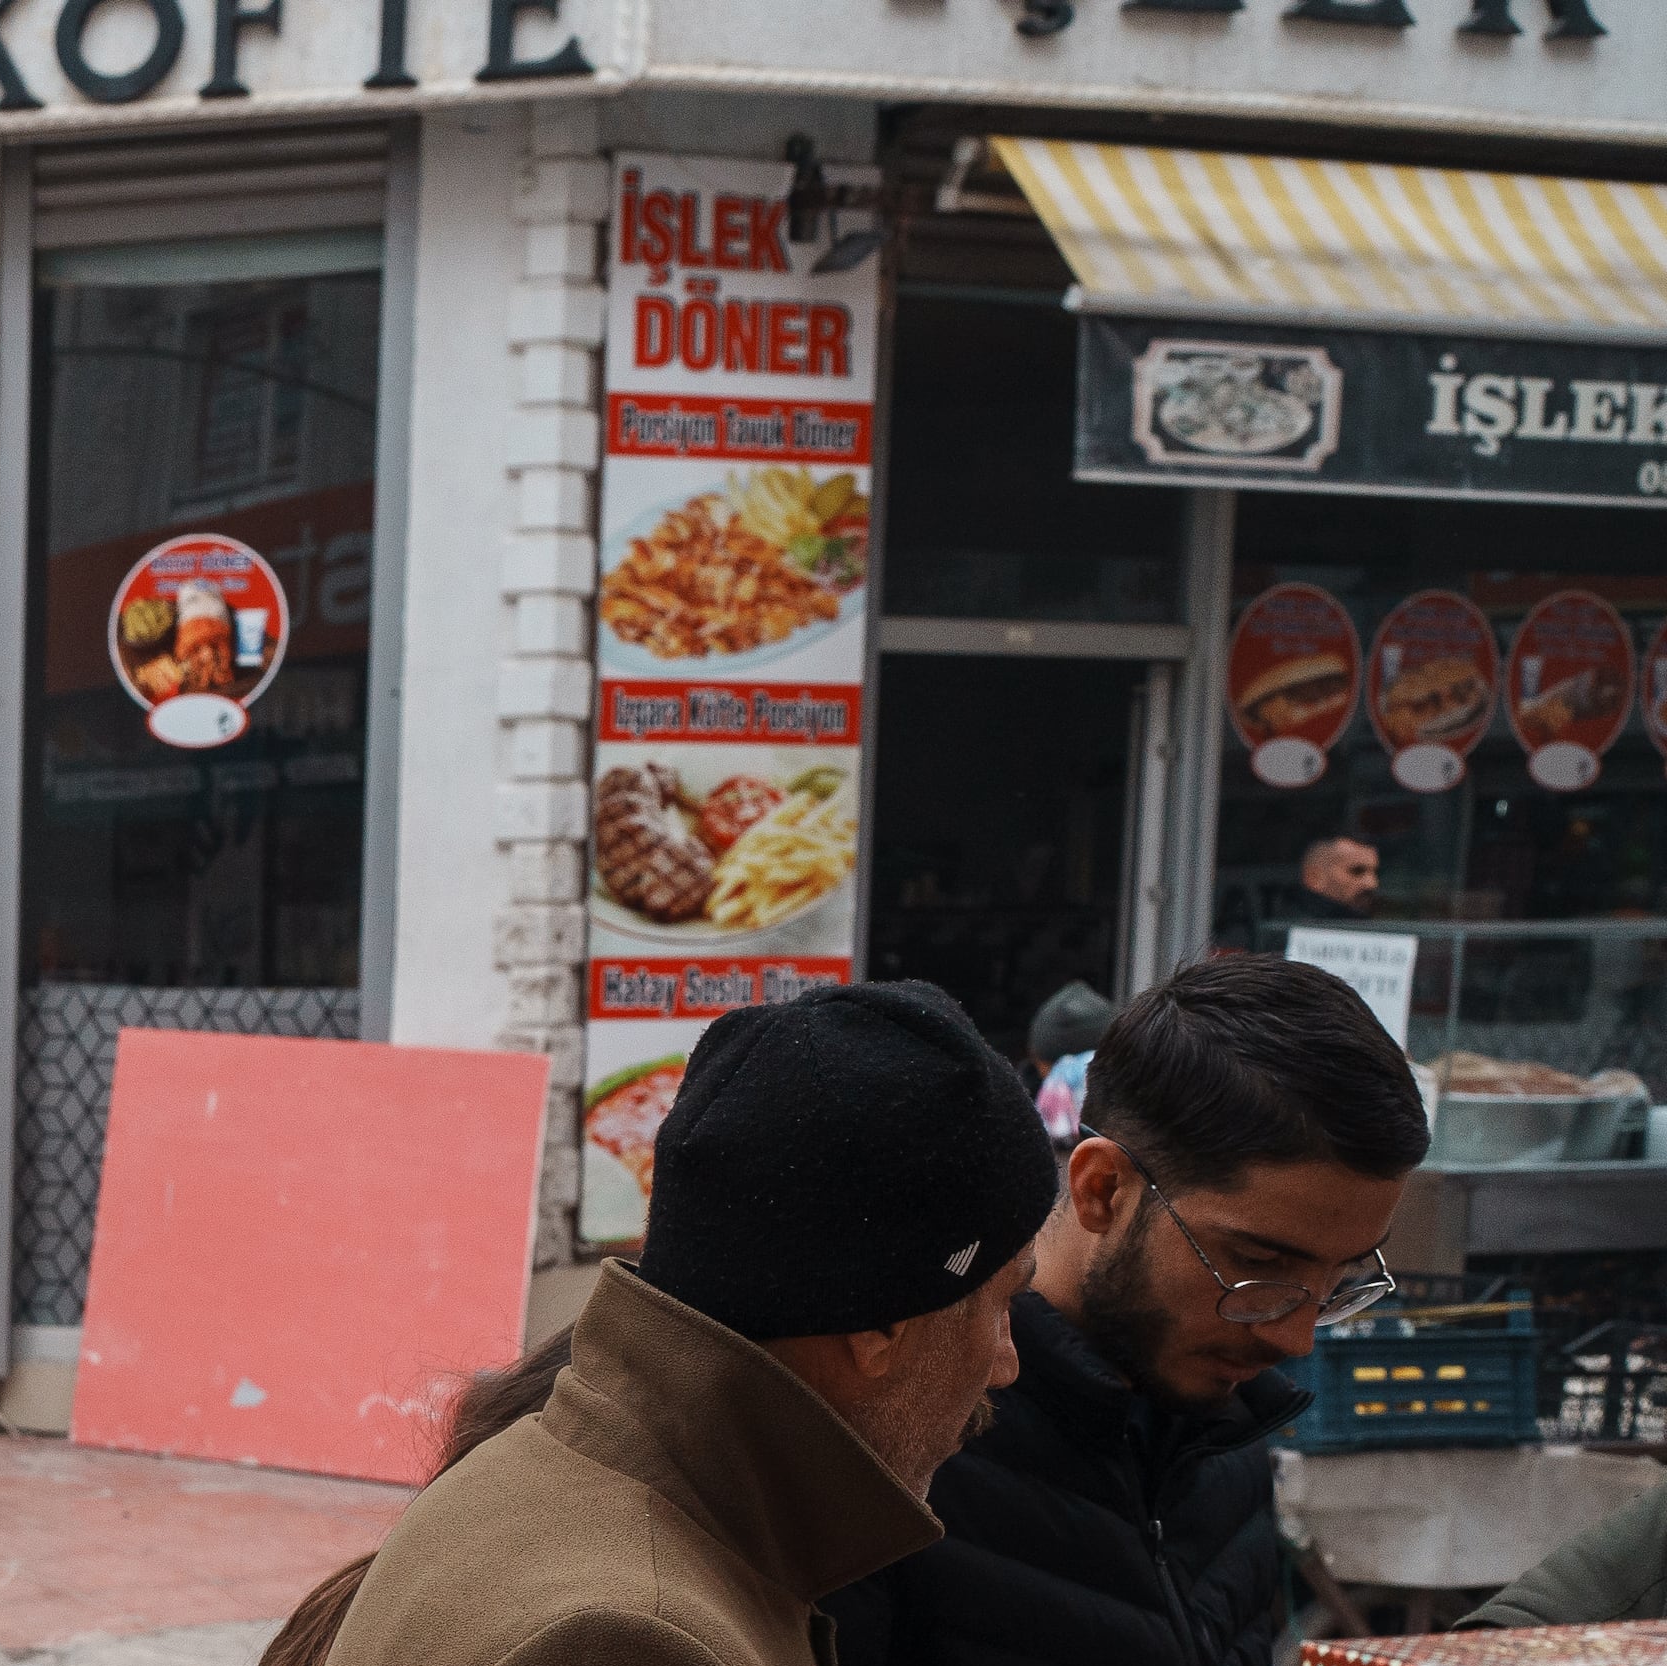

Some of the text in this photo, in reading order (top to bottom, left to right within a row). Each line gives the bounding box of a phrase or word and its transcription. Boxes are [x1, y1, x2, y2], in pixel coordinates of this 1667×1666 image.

[620, 168, 792, 288] İŞLEK
[633, 276, 855, 380] DÖNER
[1425, 353, 1667, 456] İŞLEK
